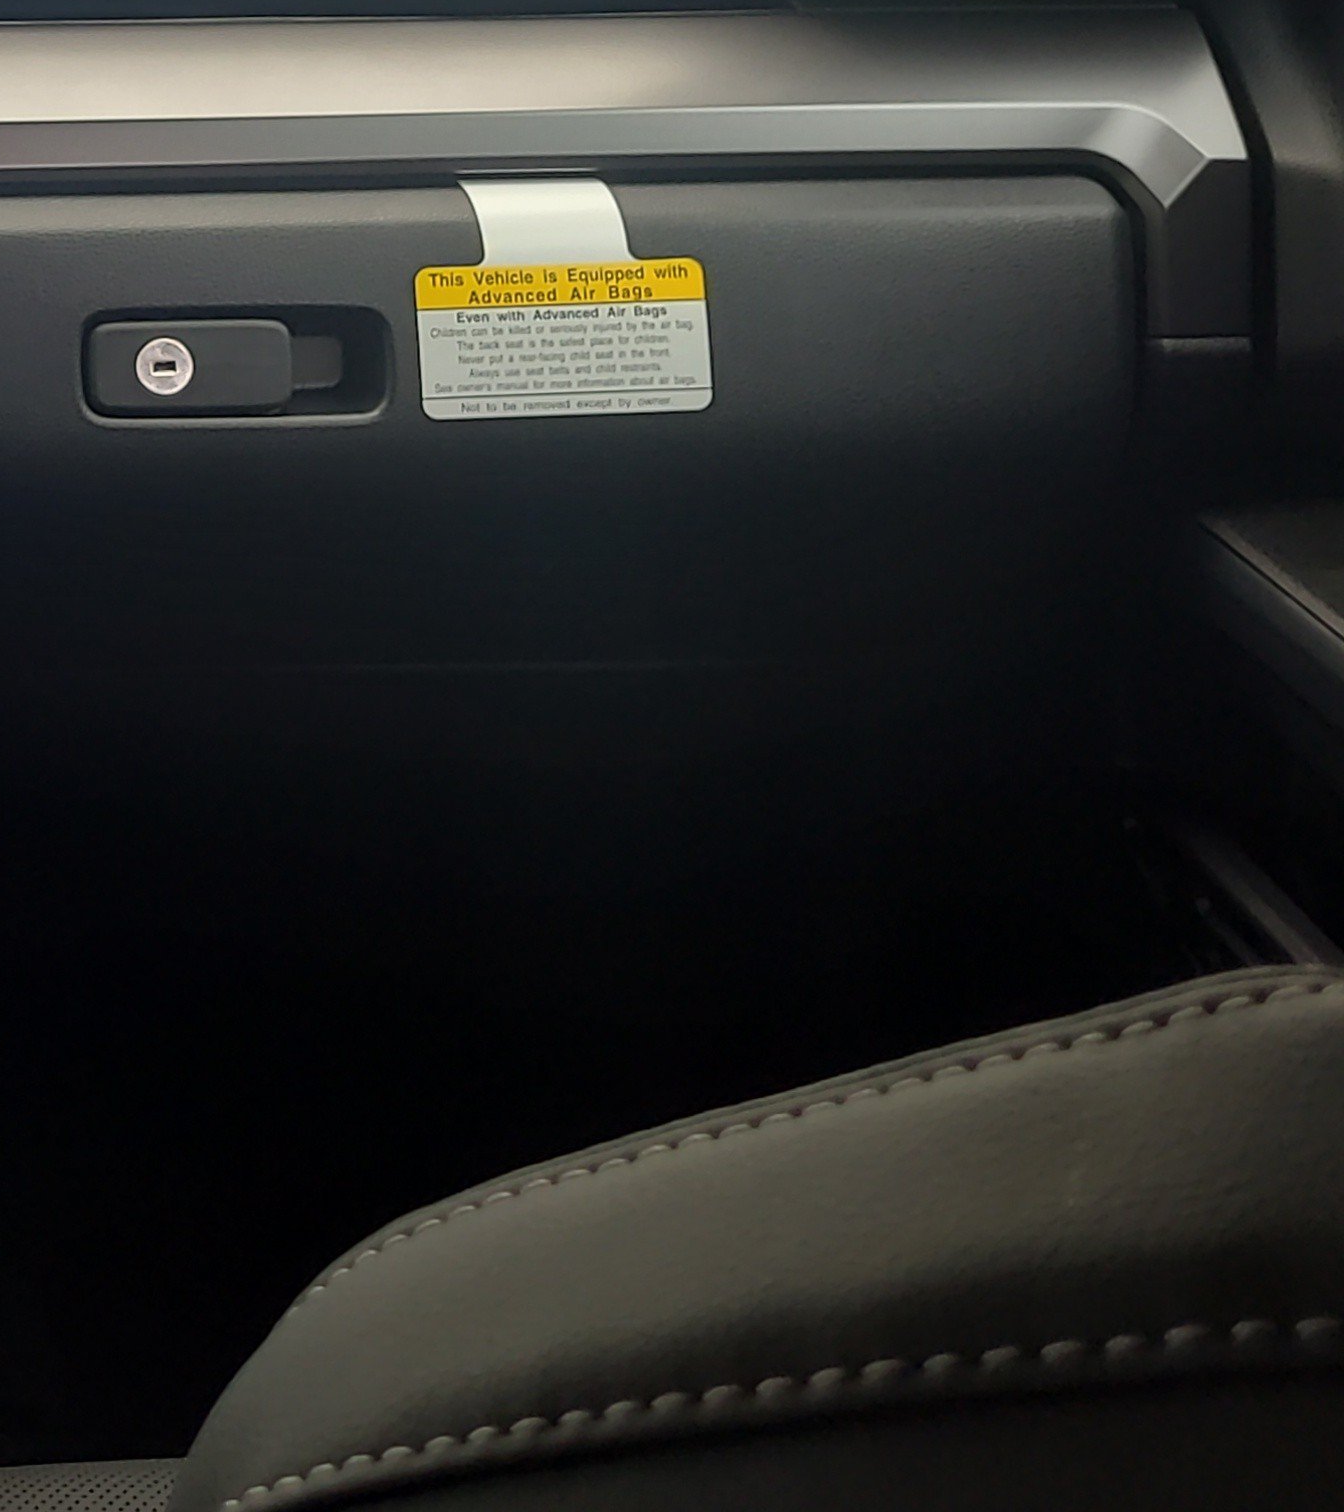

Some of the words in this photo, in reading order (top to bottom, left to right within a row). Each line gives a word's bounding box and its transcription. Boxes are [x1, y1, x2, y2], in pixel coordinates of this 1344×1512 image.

[427, 272, 465, 289] This
[473, 269, 534, 287] Vehicle
[543, 268, 558, 284] is
[566, 266, 645, 287] Equipped
[653, 263, 689, 280] with
[468, 289, 558, 305] Advanced
[570, 287, 596, 301] Air
[608, 284, 654, 301] Bags
[456, 311, 490, 324] Even
[497, 309, 525, 322] with
[532, 307, 600, 322] Advanced
[606, 306, 627, 318] Air
[633, 305, 668, 319] Bags
[461, 402, 480, 413] Not
[486, 402, 498, 411] to
[502, 401, 517, 410] be
[523, 400, 571, 410] removed
[576, 398, 612, 409] except
[618, 398, 631, 409] by
